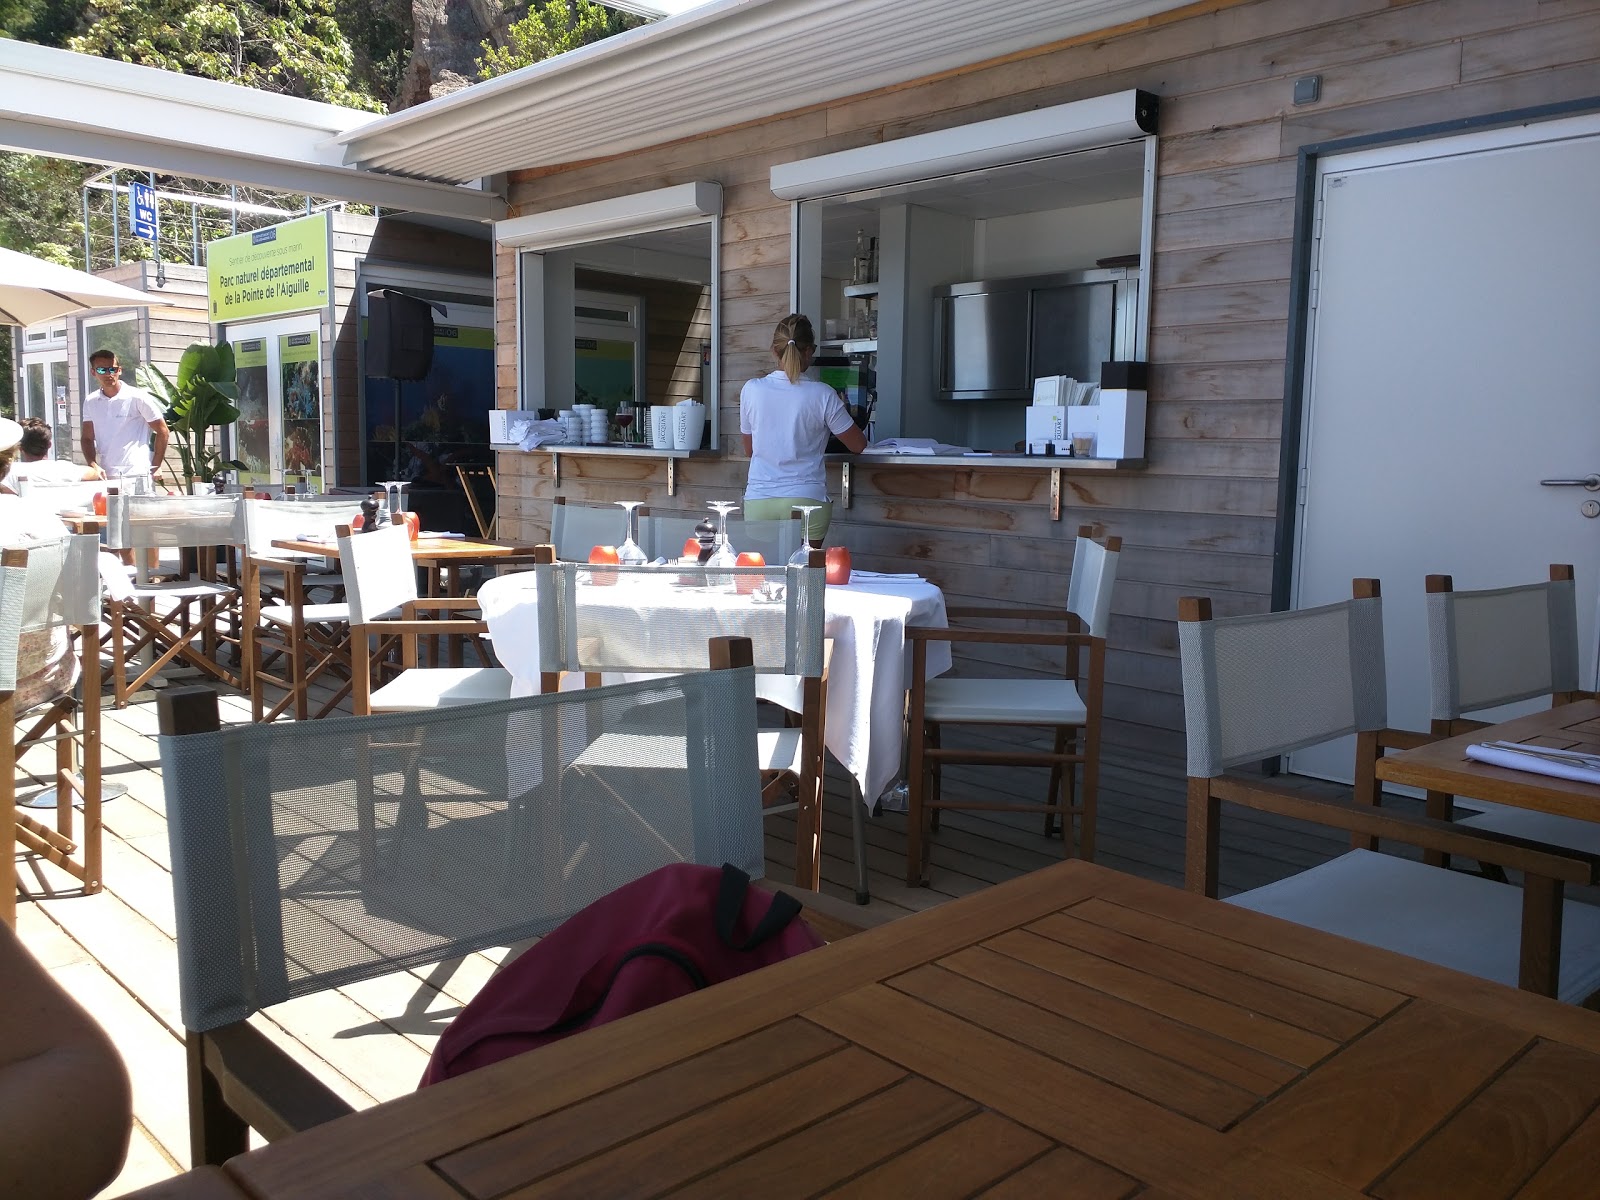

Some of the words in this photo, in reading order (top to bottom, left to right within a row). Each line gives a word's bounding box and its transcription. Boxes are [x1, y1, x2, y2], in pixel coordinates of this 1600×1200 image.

[139, 209, 153, 222] WC
[276, 246, 288, 255] sous
[220, 275, 234, 288] Parc
[235, 268, 259, 285] naturel
[260, 256, 315, 280] départemental
[224, 293, 233, 305] de
[234, 291, 241, 304] la
[242, 287, 264, 303] Pointe
[265, 285, 275, 298] de
[276, 279, 310, 297] l'Aiguille
[447, 329, 457, 337] 06
[679, 411, 687, 444] JACQUART
